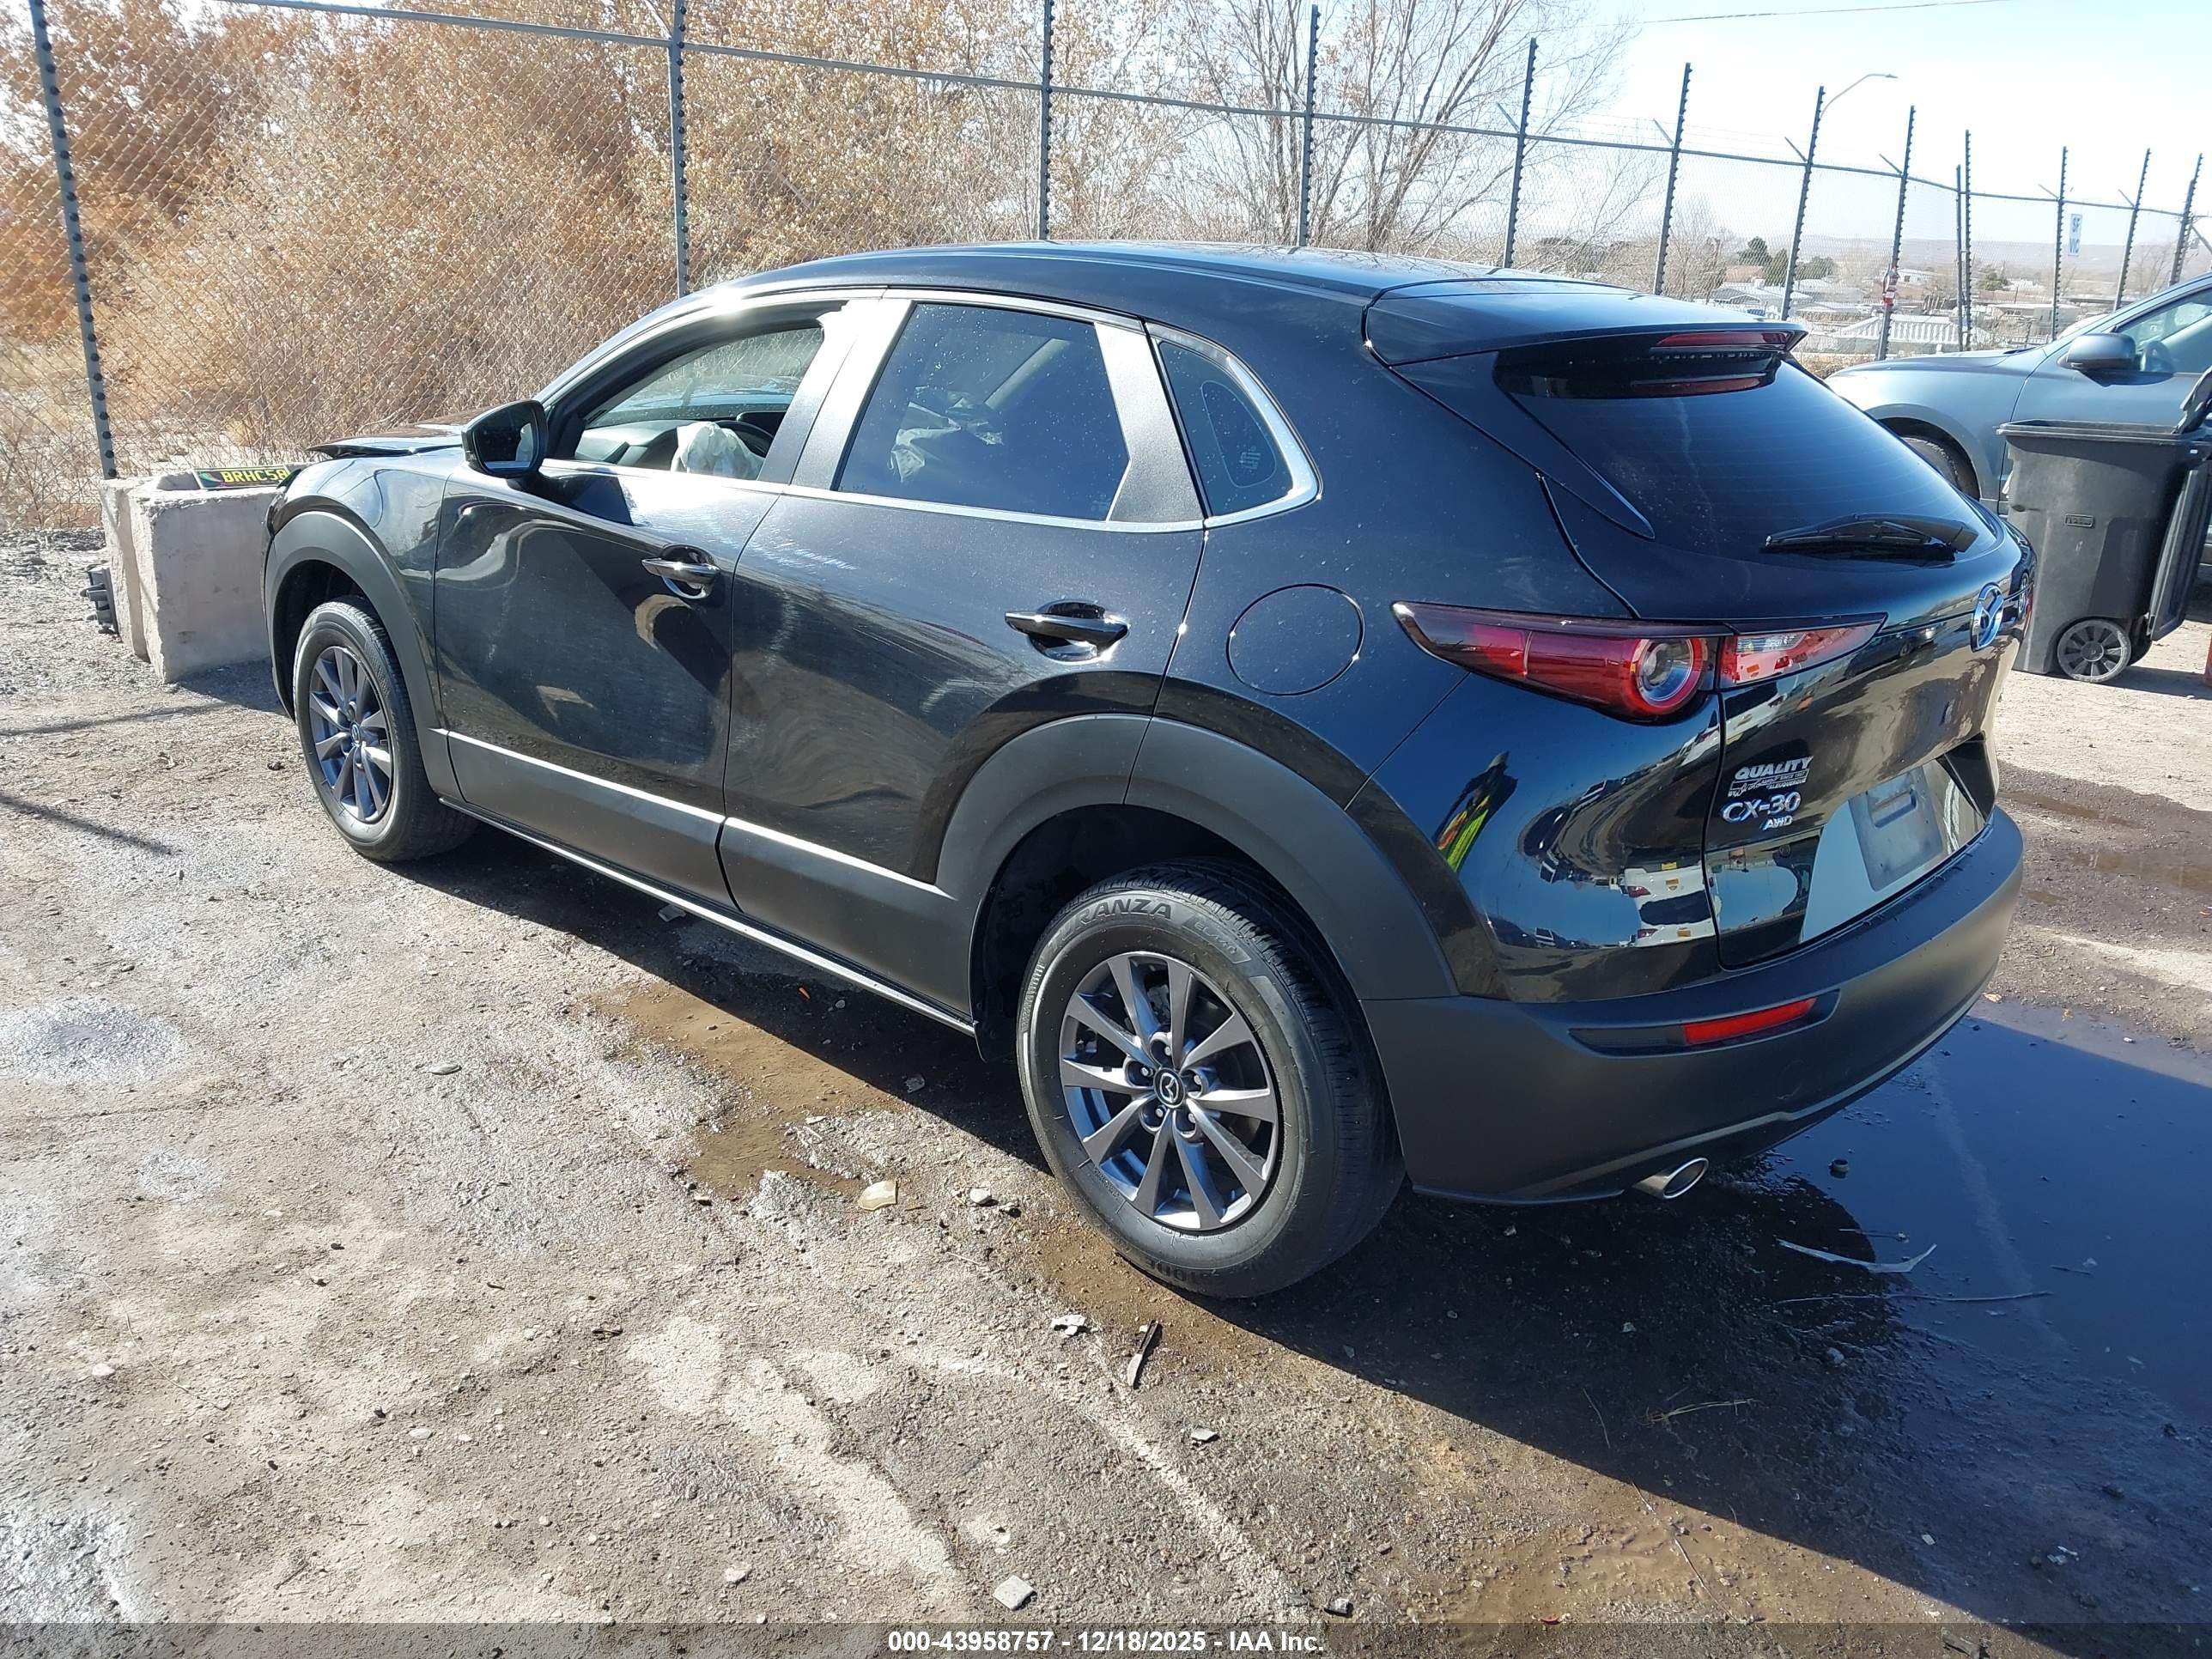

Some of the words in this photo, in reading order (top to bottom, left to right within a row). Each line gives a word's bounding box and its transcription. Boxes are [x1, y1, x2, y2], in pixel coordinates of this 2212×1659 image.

[1735, 756, 1814, 780] QUALITY
[1723, 792, 1802, 823] CX-30
[1762, 815, 1793, 831] AWD
